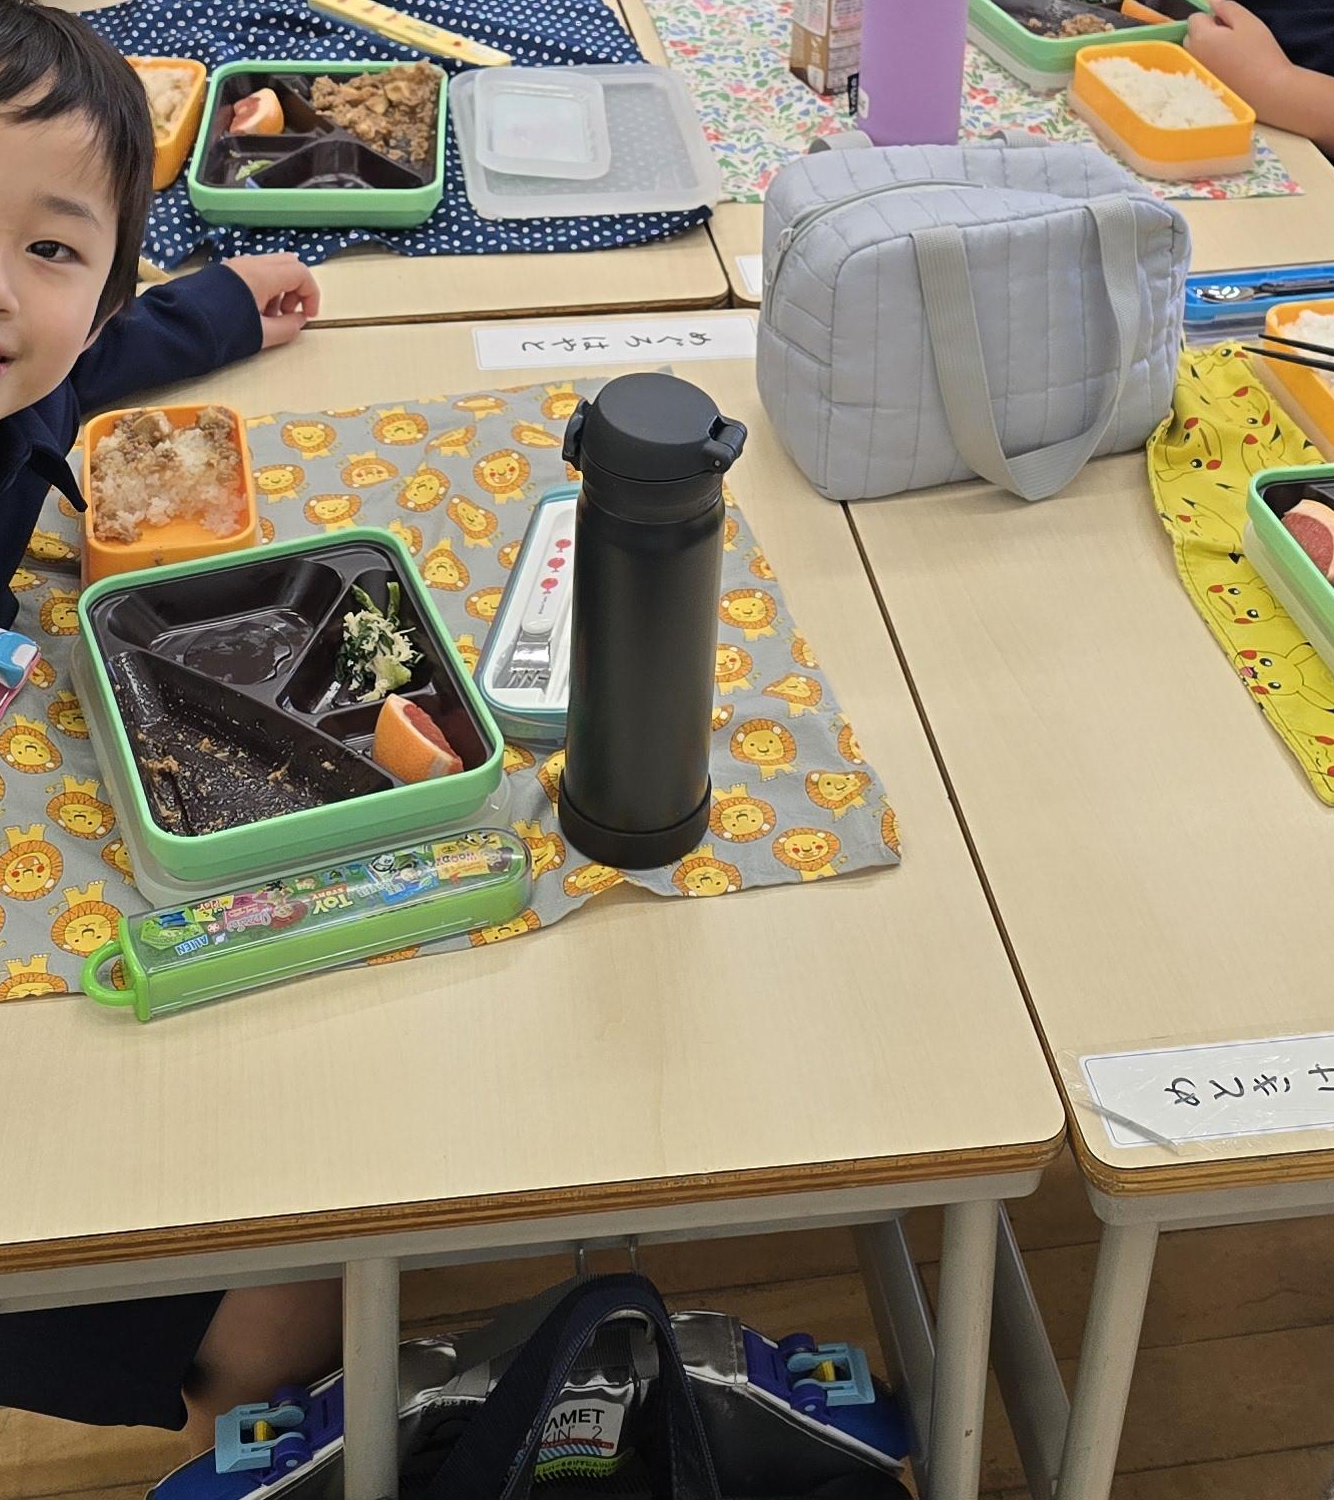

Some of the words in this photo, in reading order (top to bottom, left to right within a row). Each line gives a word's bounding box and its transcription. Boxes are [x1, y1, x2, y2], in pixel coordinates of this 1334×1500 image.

[522, 336, 610, 352] はやと
[311, 886, 345, 901] STORY
[312, 893, 354, 915] TOY
[176, 934, 208, 955] ALIEN
[1164, 1073, 1291, 1107] めとき
[546, 1408, 605, 1433] AMET
